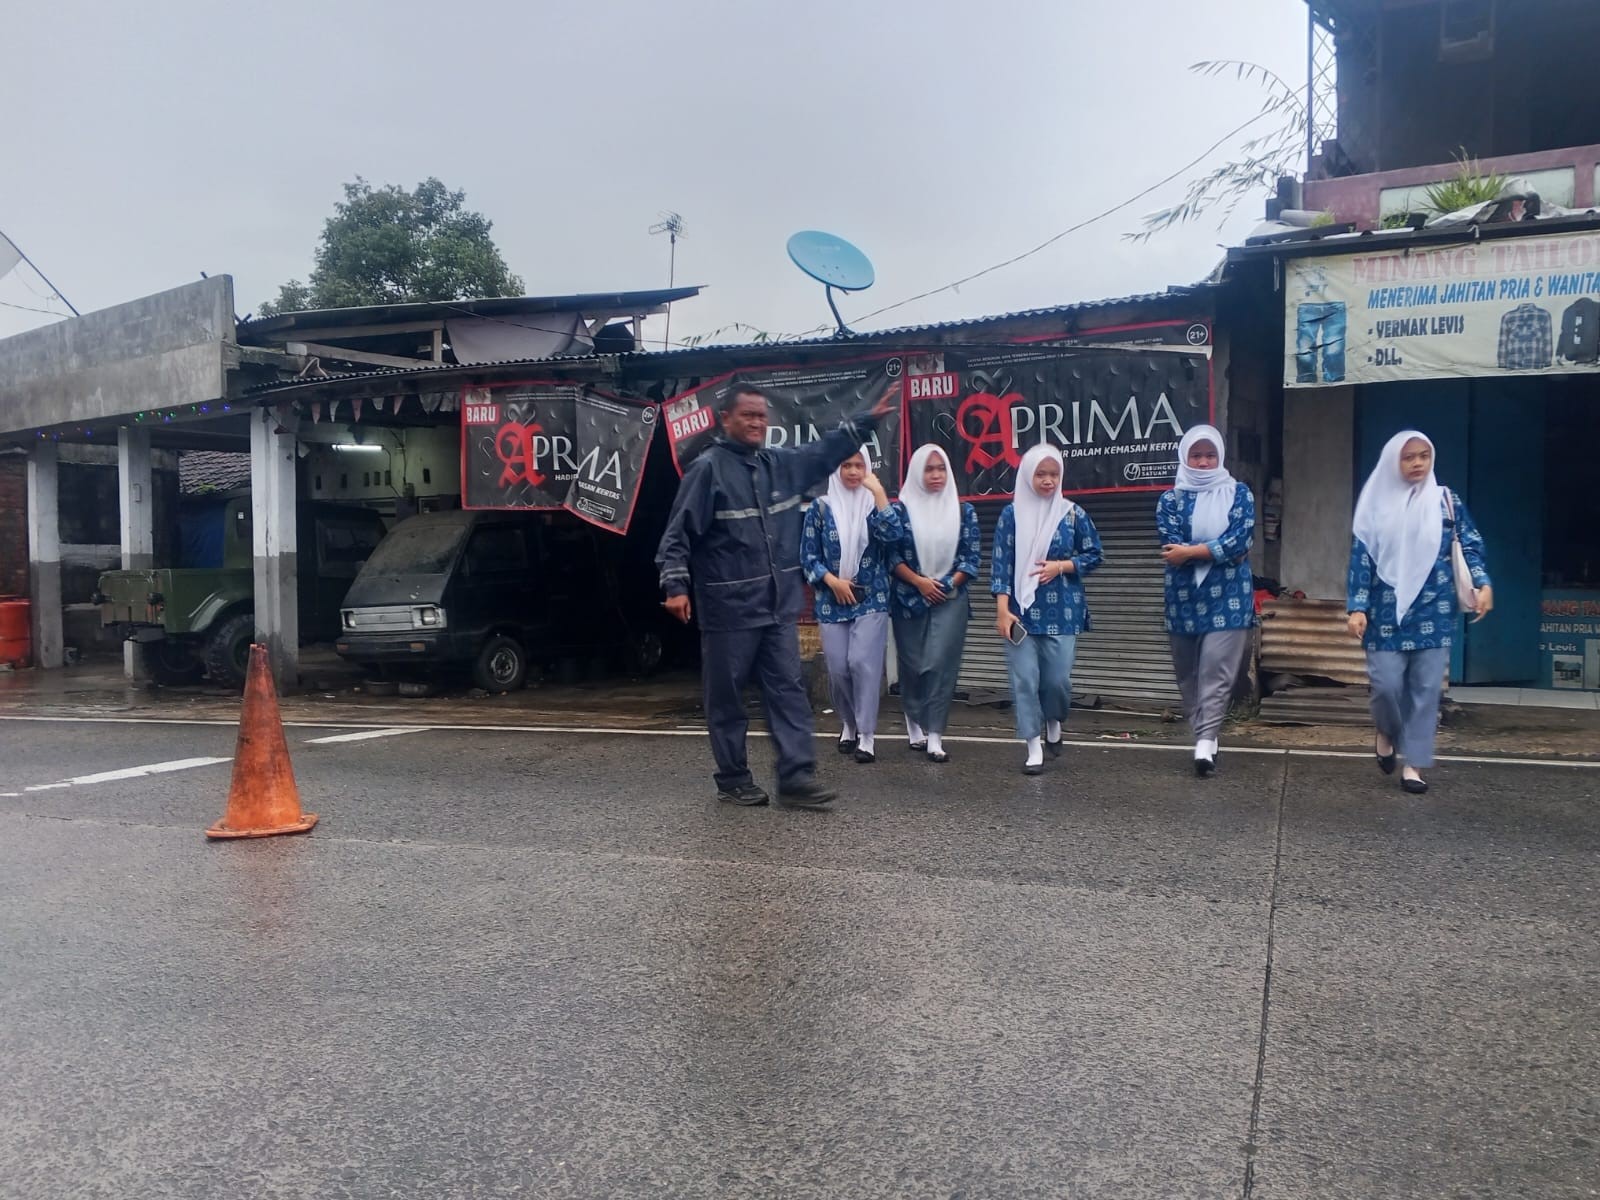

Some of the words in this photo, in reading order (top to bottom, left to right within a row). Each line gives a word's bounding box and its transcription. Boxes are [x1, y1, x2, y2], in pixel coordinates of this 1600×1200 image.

[1352, 247, 1476, 287] MINANG
[1491, 236, 1600, 274] TAILO
[1367, 284, 1438, 309] MENERIMA
[1440, 279, 1494, 305] JAHITAN
[1500, 277, 1530, 300] PRIA
[1534, 276, 1544, 298] &
[1190, 330, 1205, 340] 21+
[1376, 317, 1428, 339] VERMAK
[888, 363, 901, 372] 21+
[911, 375, 954, 399] BARU
[467, 406, 496, 423] BARU
[673, 409, 710, 440] BARU
[1071, 447, 1102, 458] DALAM
[1104, 444, 1148, 456] KEMASAN
[1149, 441, 1180, 452] KERTA
[1540, 622, 1572, 633] AHITAN
[1573, 623, 1593, 634] PRIA
